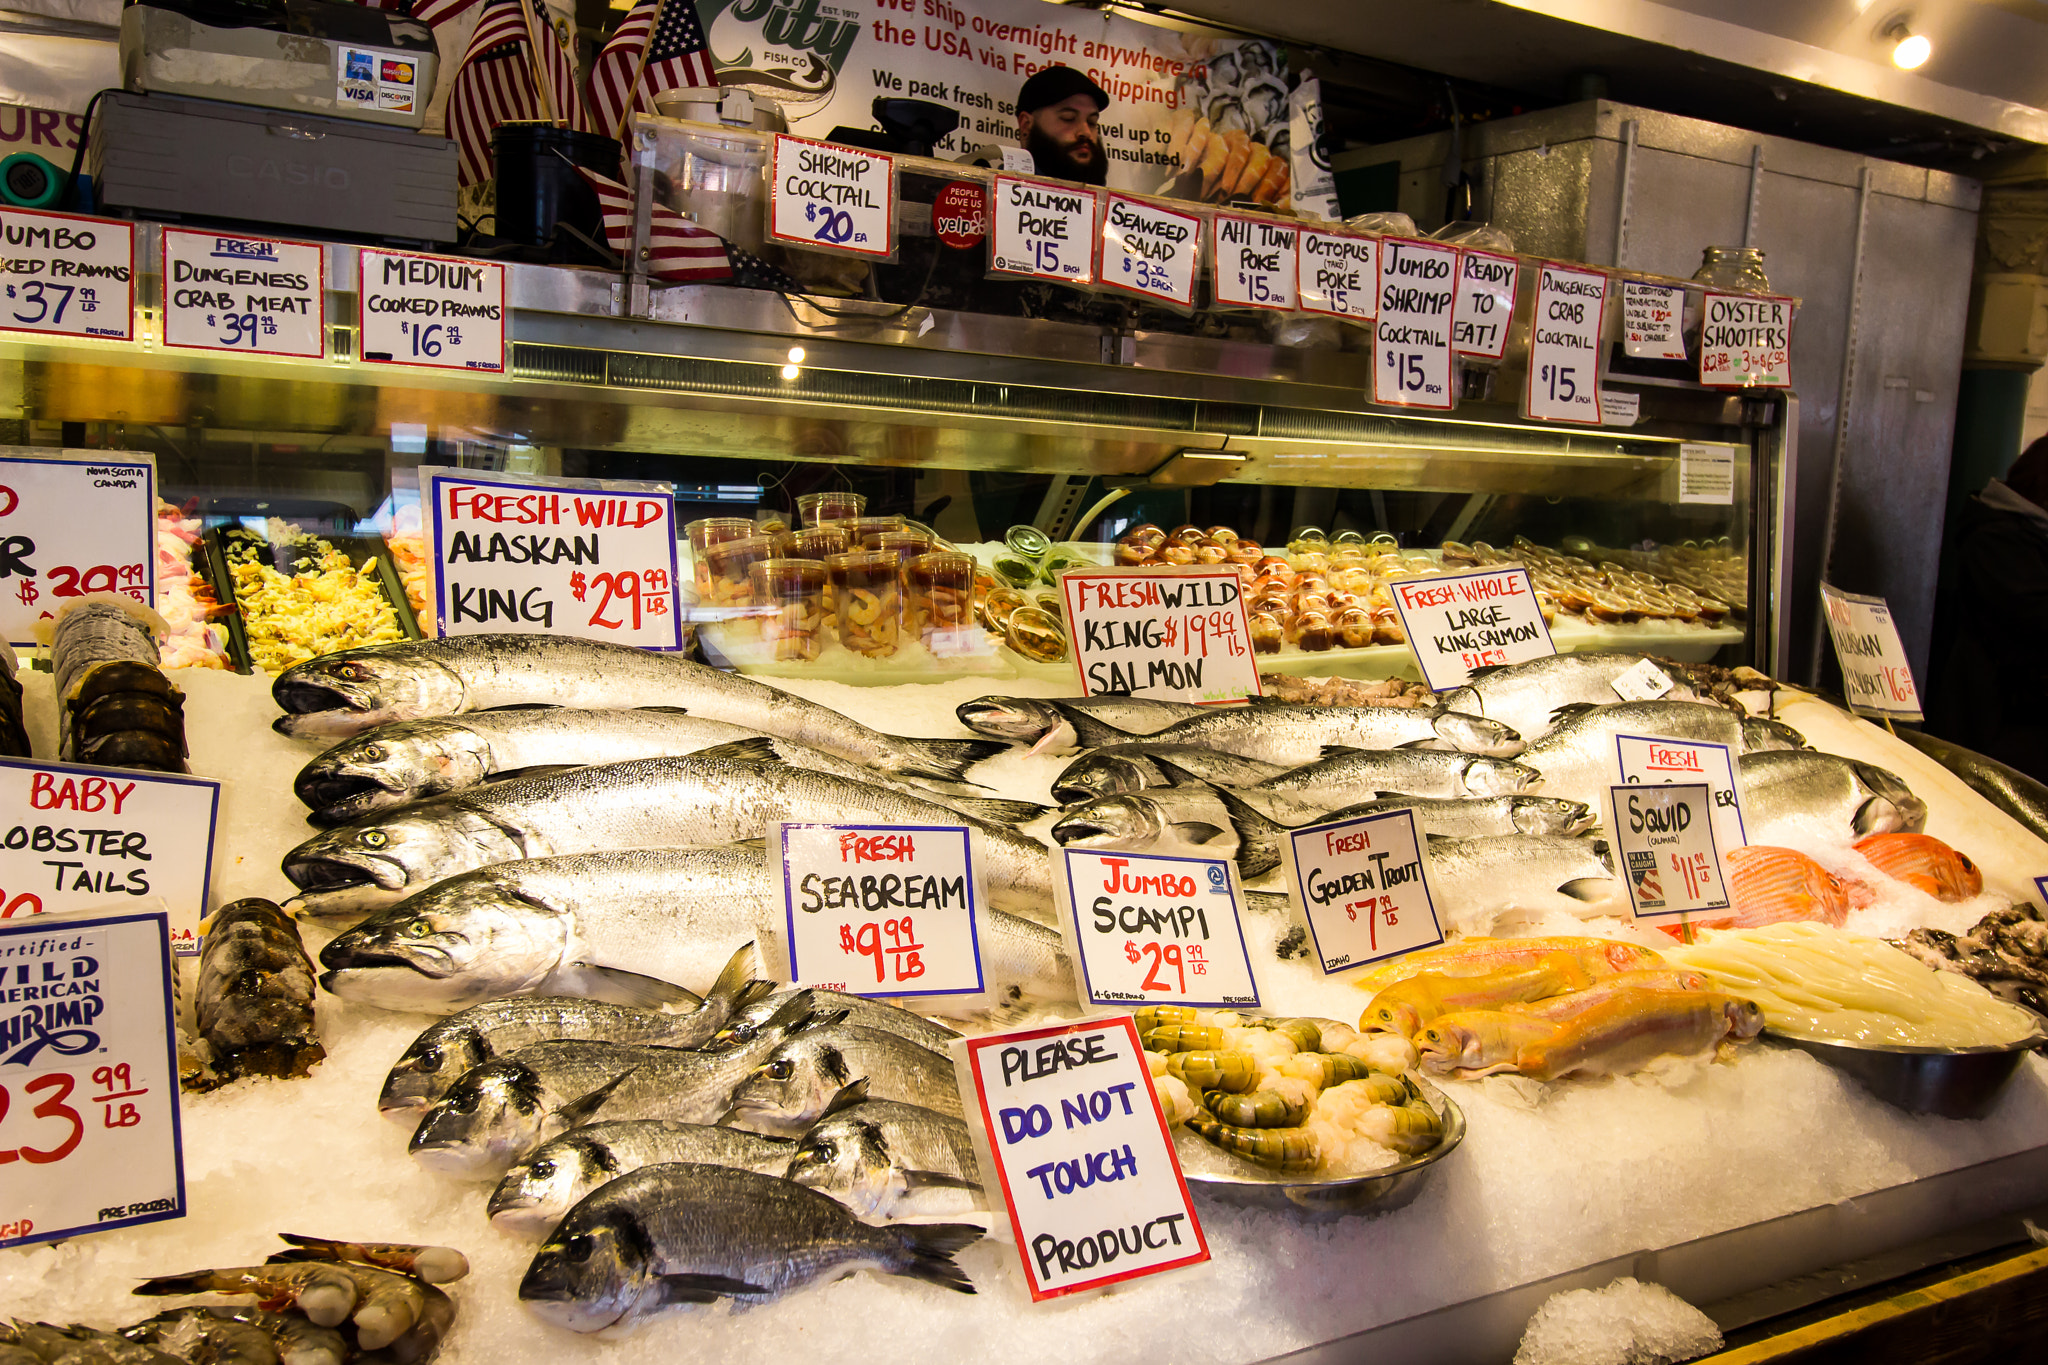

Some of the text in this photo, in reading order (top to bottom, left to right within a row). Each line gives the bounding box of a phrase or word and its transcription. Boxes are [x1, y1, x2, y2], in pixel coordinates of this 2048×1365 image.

[822, 6, 860, 19] EST. 1917
[872, 19, 916, 46] the
[924, 26, 973, 61] USA
[978, 46, 1007, 72] via
[924, 0, 966, 30] ship
[972, 16, 1078, 55] overnight
[1083, 40, 1184, 77] anywhere
[764, 51, 789, 64] FISH
[344, 86, 375, 101] VISA
[381, 92, 411, 101] DISCOVER
[872, 69, 902, 91] We
[908, 80, 949, 100] pack
[953, 85, 993, 110] fresh
[1128, 128, 1149, 145] up
[1154, 129, 1171, 144] to
[799, 149, 870, 182] SHRIMP
[1106, 143, 1186, 170] insulated,
[227, 154, 350, 190] CASIO
[786, 176, 880, 209] COCKTAIL
[945, 197, 982, 208] LOVE US
[951, 188, 979, 198] PEOPLE
[1010, 184, 1082, 214] SALMON
[0, 216, 96, 250] UMBO
[805, 201, 867, 244] $20 EA
[939, 217, 971, 236] yelp
[1018, 211, 1068, 240] POKÉ
[1111, 202, 1188, 243] SEAWEED
[1221, 221, 1295, 250] AHI TUNA
[216, 238, 272, 255] FRESH
[1026, 239, 1080, 274] $15 EACH
[1122, 234, 1175, 262] SALAD
[1240, 248, 1280, 272] POKÉ
[1306, 235, 1369, 263] OCTOPUS
[51, 259, 130, 282] PRAWNS
[383, 257, 486, 293] MEDIUM
[1122, 257, 1149, 288] $3
[1384, 243, 1450, 279] JUMBO
[1463, 255, 1514, 287] READY
[174, 260, 309, 291] DUNGENESS
[1151, 278, 1173, 293] EACH
[1238, 272, 1285, 303] $15 EACH
[1316, 270, 1361, 291] POKÉ
[1542, 271, 1602, 299] DUNGENESS
[1627, 285, 1636, 294] ALL
[82, 303, 96, 312] LB
[174, 289, 312, 315] CRAB MEAT
[368, 295, 500, 320] COOKED PRAWNS
[1322, 289, 1348, 312] $15
[1382, 284, 1452, 315] SHRIMP
[1472, 293, 1494, 314] TO
[1549, 300, 1585, 324] CRAB
[1625, 298, 1668, 309] TRANSACTIONS
[1711, 301, 1783, 325] OYSTER
[1626, 309, 1648, 319] UNDER
[1637, 322, 1671, 332] SUBJECT TO
[264, 326, 277, 335] LB
[449, 337, 461, 345] LB
[1378, 321, 1446, 347] COCKTAIL
[1452, 321, 1497, 349] EAT!
[1536, 328, 1594, 349] COCKTAIL
[1704, 326, 1786, 349] SHOOTERS
[1387, 351, 1442, 394] $15 EACH
[1742, 350, 1750, 372] 3
[1541, 364, 1591, 404] $15 EACH
[86, 468, 143, 478] NOVA SCOTIA
[94, 480, 137, 489] CANADA
[448, 531, 599, 566] ALASKAN
[118, 563, 144, 586] 99
[451, 569, 668, 630] KING $29 99
[646, 597, 668, 616] LB
[1078, 581, 1238, 612] FRESH WILD
[1445, 605, 1511, 631] LARGE
[1084, 611, 1235, 658] KING $19 99
[1433, 621, 1539, 654] KING SALMON
[1837, 630, 1883, 657] ALASKAN
[1088, 658, 1202, 697] SALMON
[1649, 744, 1698, 767] FRESH
[30, 773, 136, 814] BABY
[1628, 794, 1691, 834] SQUID
[838, 832, 915, 863] FRESH
[1326, 831, 1371, 856] FRESH
[1629, 852, 1653, 860] WILD
[43, 860, 150, 896] TAILS
[1100, 857, 1196, 897] JUMBO
[1631, 860, 1655, 868] CAUGHT
[1671, 853, 1700, 900] $11
[1700, 871, 1710, 883] LB
[800, 873, 966, 913] SEABREAM
[1308, 852, 1418, 906] GOLDEN TROUT
[1092, 896, 1210, 940] SCAMPI
[1345, 895, 1393, 951] $7 99
[1386, 912, 1398, 926] LB
[839, 916, 915, 983] $9 99
[1326, 954, 1350, 969] IDAHO
[896, 952, 925, 982] LB
[1124, 940, 1203, 994] $29 99
[1193, 963, 1207, 975] LB
[828, 982, 846, 991] FISH
[1000, 1034, 1118, 1087] PLEASE
[92, 1063, 132, 1092] 99
[104, 1103, 141, 1128] LB
[999, 1082, 1136, 1145] DO NOT
[1026, 1144, 1138, 1200] TOUCH
[98, 1198, 175, 1221] PRE FROZEN
[1032, 1213, 1185, 1281] PRODUCT
